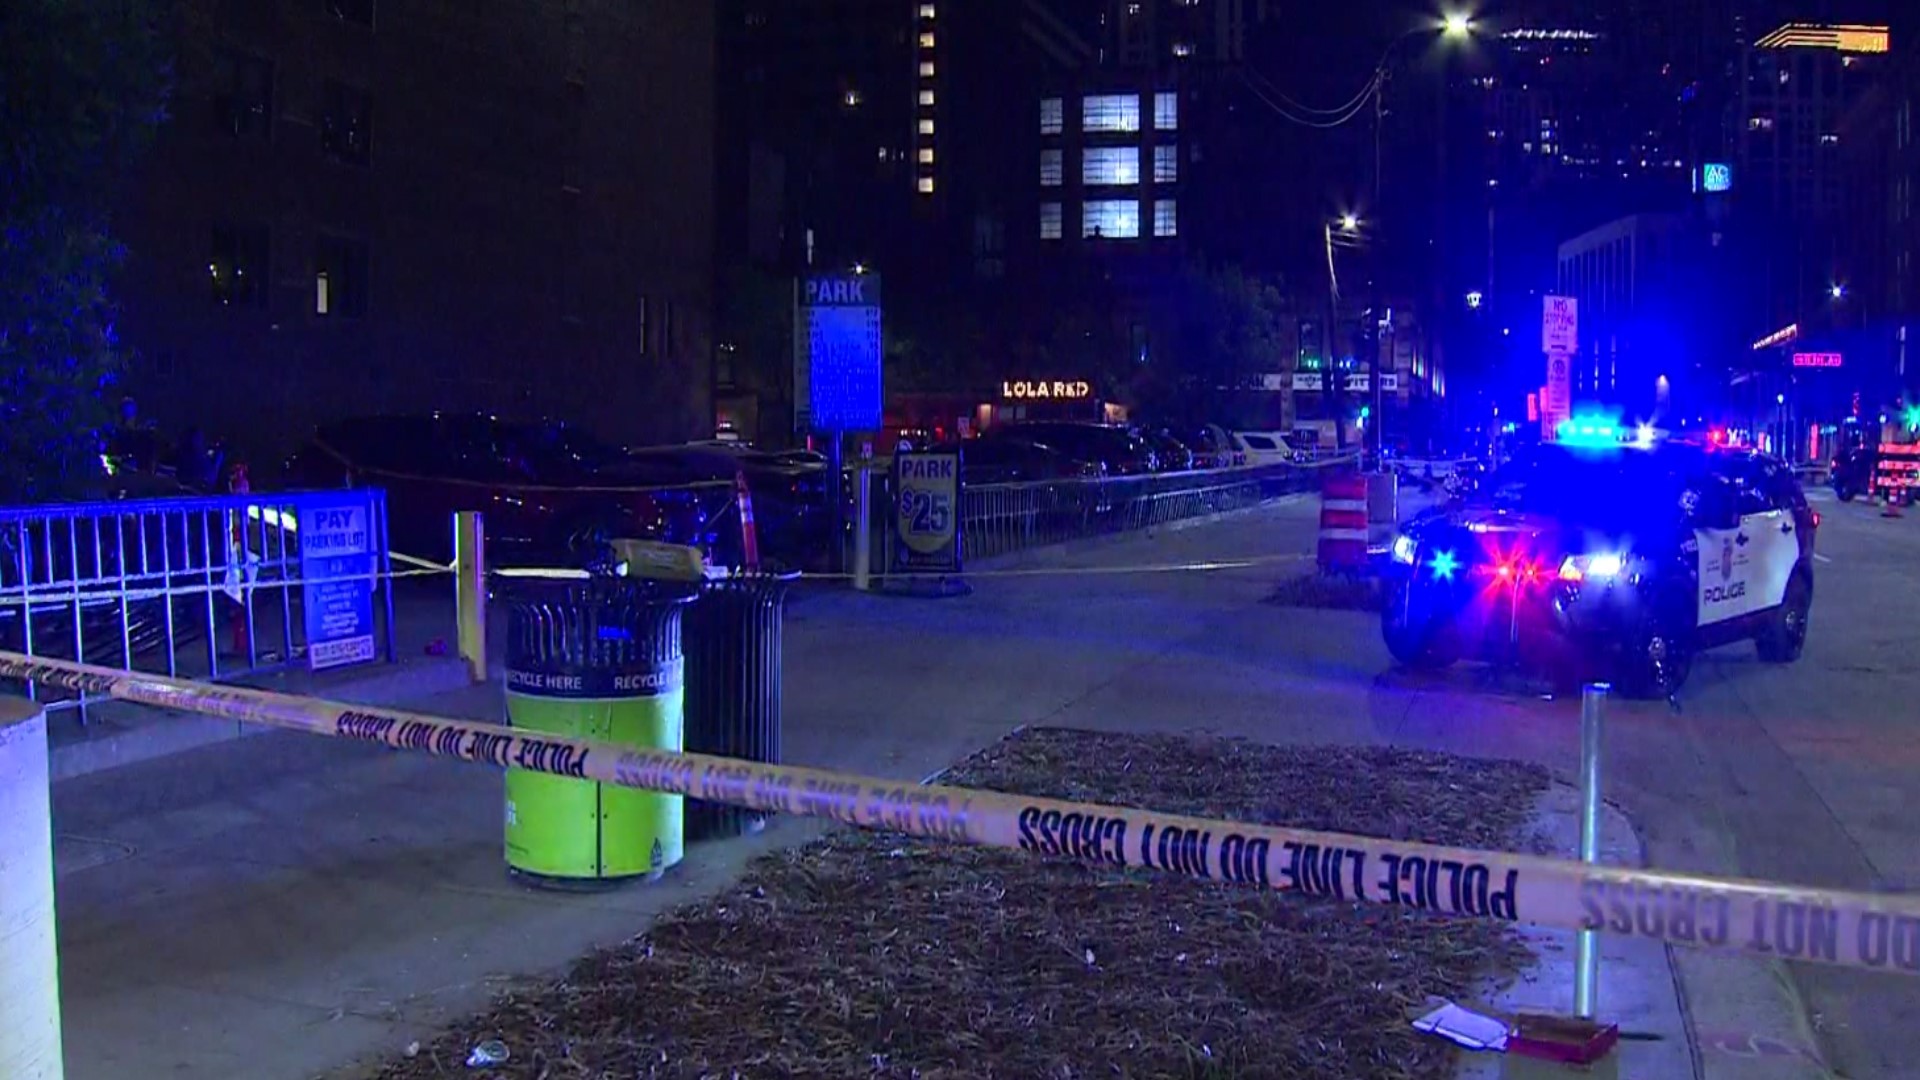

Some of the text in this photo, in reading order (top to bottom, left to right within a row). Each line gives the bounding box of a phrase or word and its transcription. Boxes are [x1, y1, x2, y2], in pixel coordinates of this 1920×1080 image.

[805, 279, 865, 303] PARK
[1003, 381, 1050, 399] LOLA
[901, 459, 953, 479] PARK
[314, 509, 353, 531] PAY
[901, 488, 950, 533] $25
[1703, 581, 1746, 606] POLICE
[507, 670, 583, 691] ECYCLE HERE
[614, 672, 665, 691] RECYCLE
[515, 736, 590, 778] POLICE
[1018, 805, 1519, 921] POLICE LINE DO NOT CROSS
[1581, 878, 1920, 972] DO NOT CROSS
